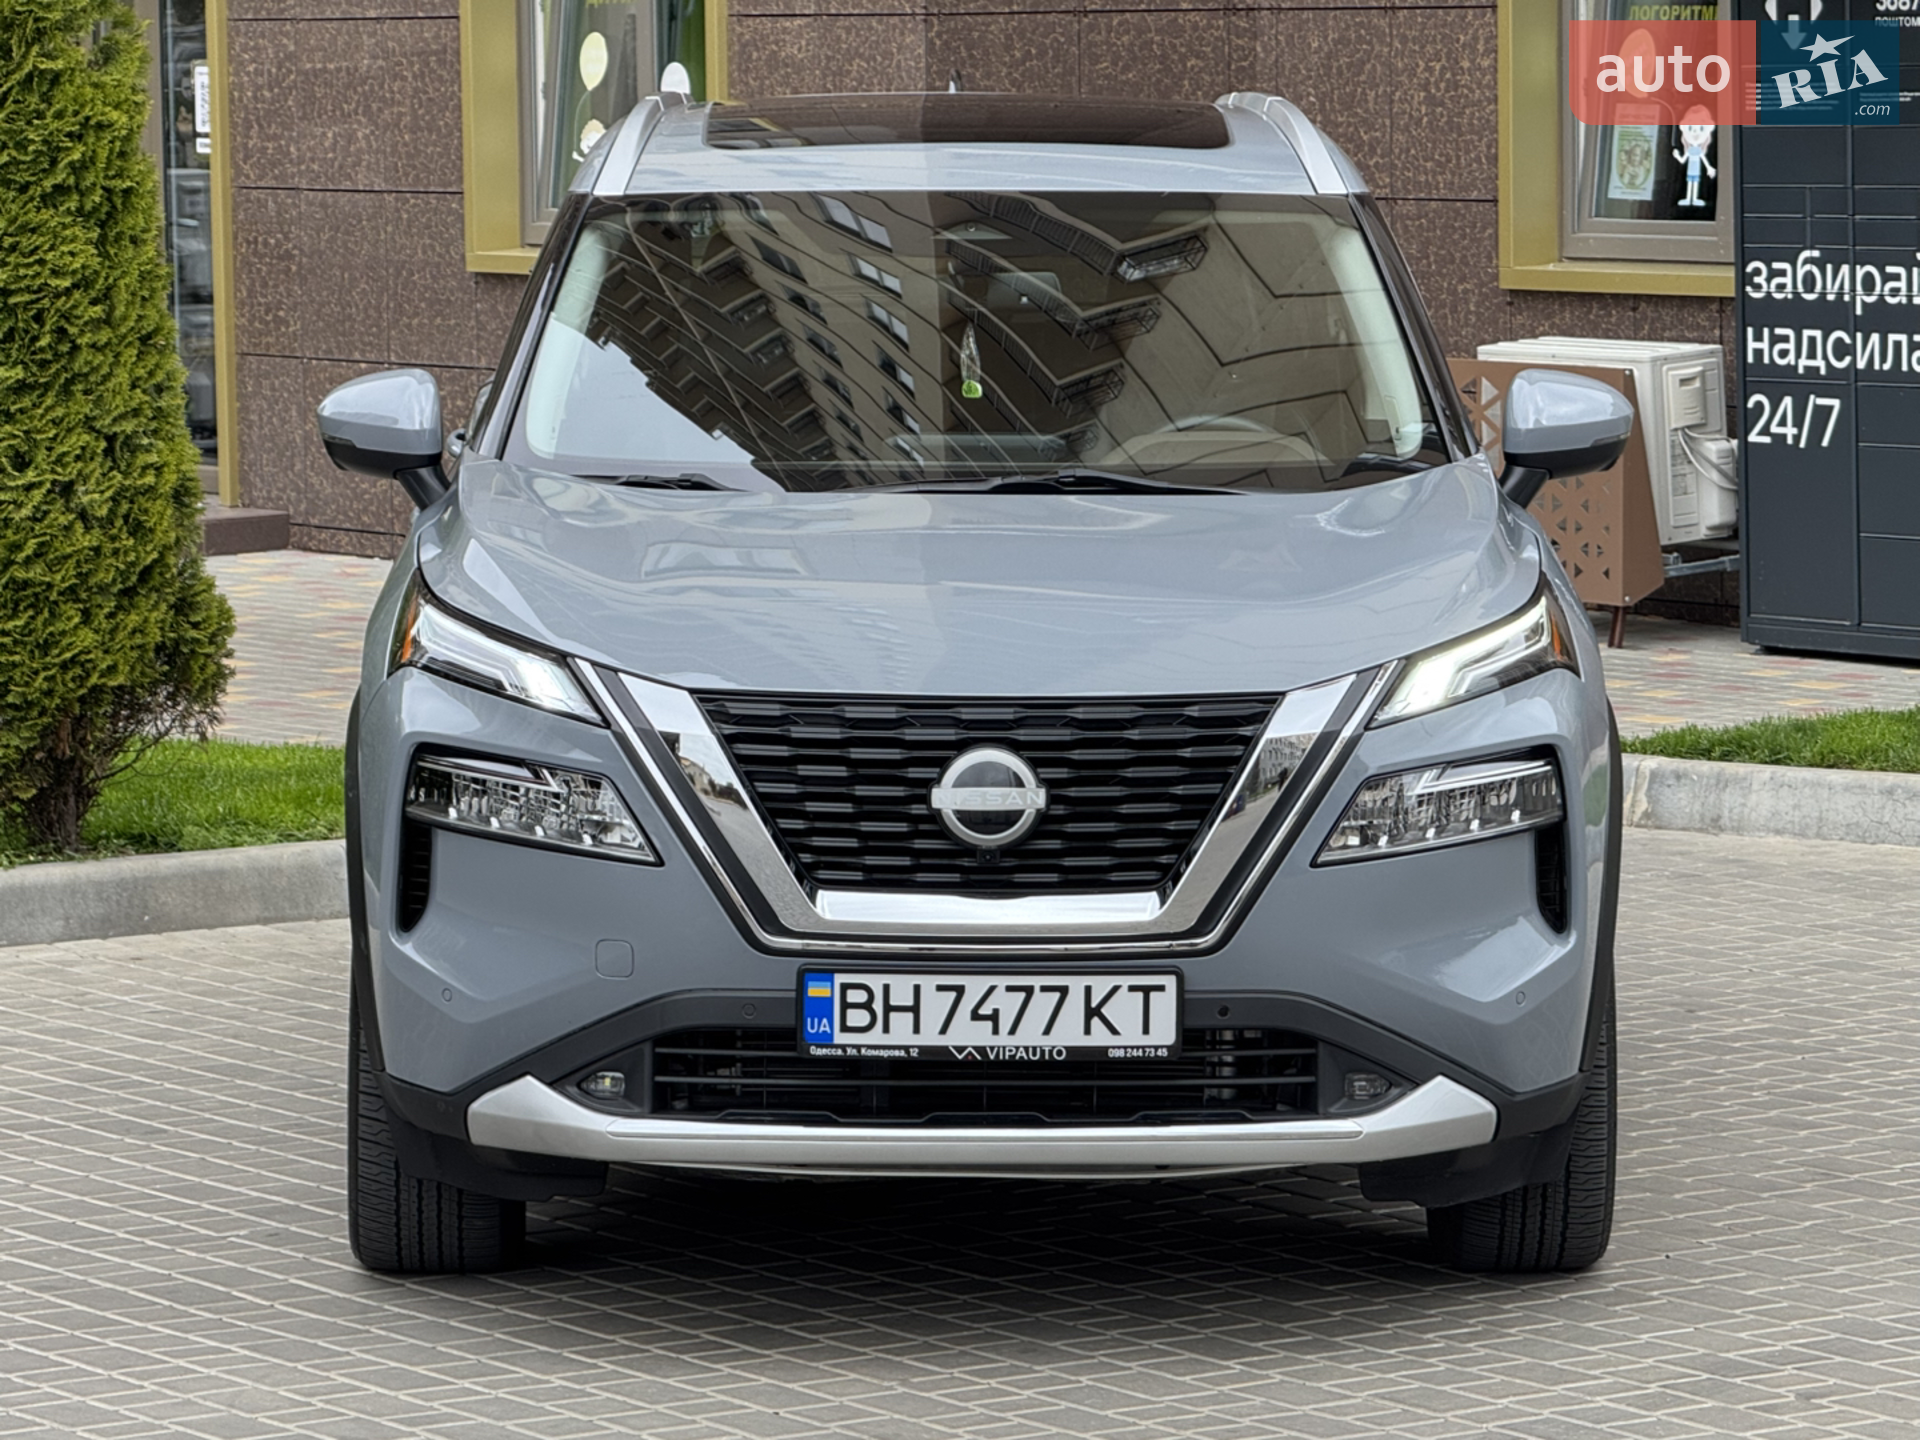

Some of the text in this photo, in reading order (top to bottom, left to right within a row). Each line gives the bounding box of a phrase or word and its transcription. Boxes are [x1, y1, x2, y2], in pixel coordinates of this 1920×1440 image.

[1628, 5, 1717, 20] ЛОГОРИТМ
[1746, 393, 1841, 449] 24/7
[934, 790, 1044, 806] NISSAN
[807, 1017, 832, 1034] UA
[909, 1047, 919, 1057] 12
[986, 1046, 1067, 1060] VIPAUTO
[1107, 1048, 1125, 1058] 098
[1126, 1048, 1144, 1058] 244
